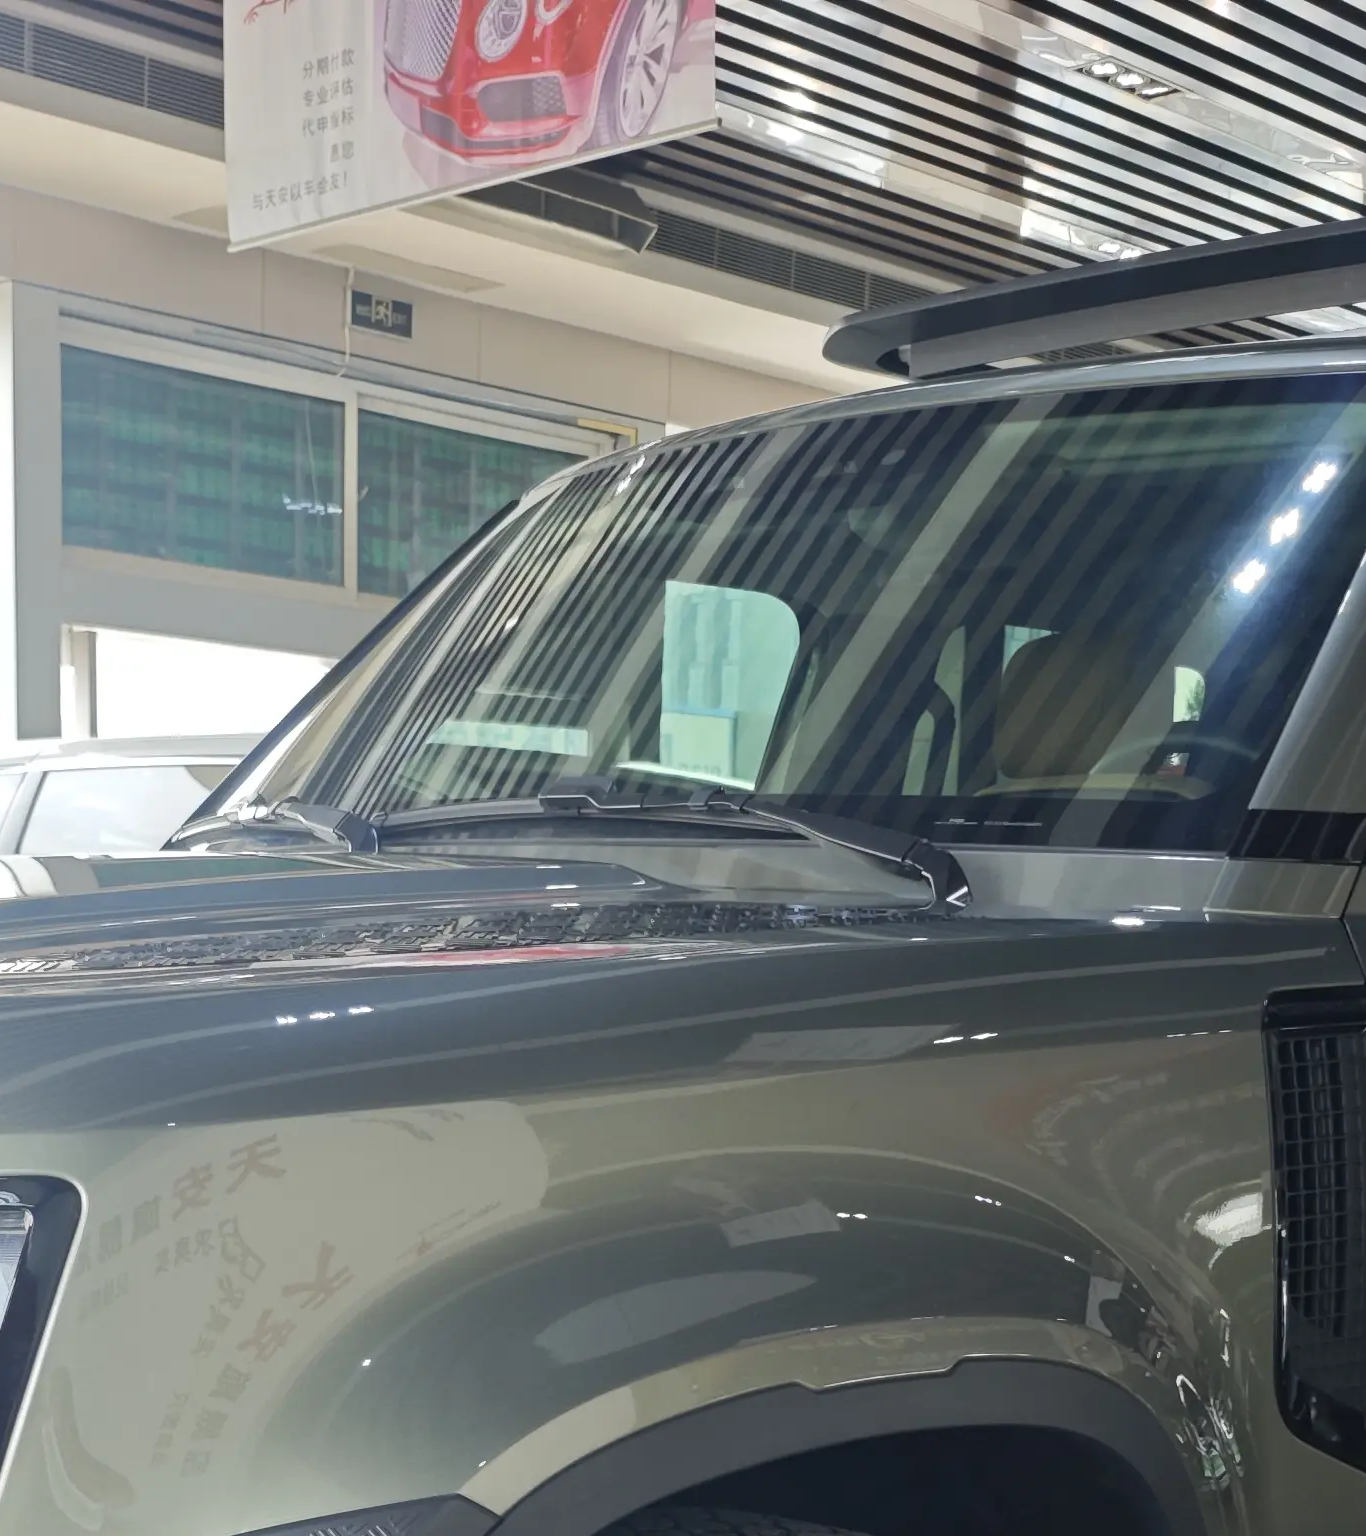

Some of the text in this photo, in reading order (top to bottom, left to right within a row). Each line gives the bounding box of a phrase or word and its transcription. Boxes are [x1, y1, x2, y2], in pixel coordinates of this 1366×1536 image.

[302, 48, 355, 79] 分期付款
[303, 77, 354, 107] 专业评估
